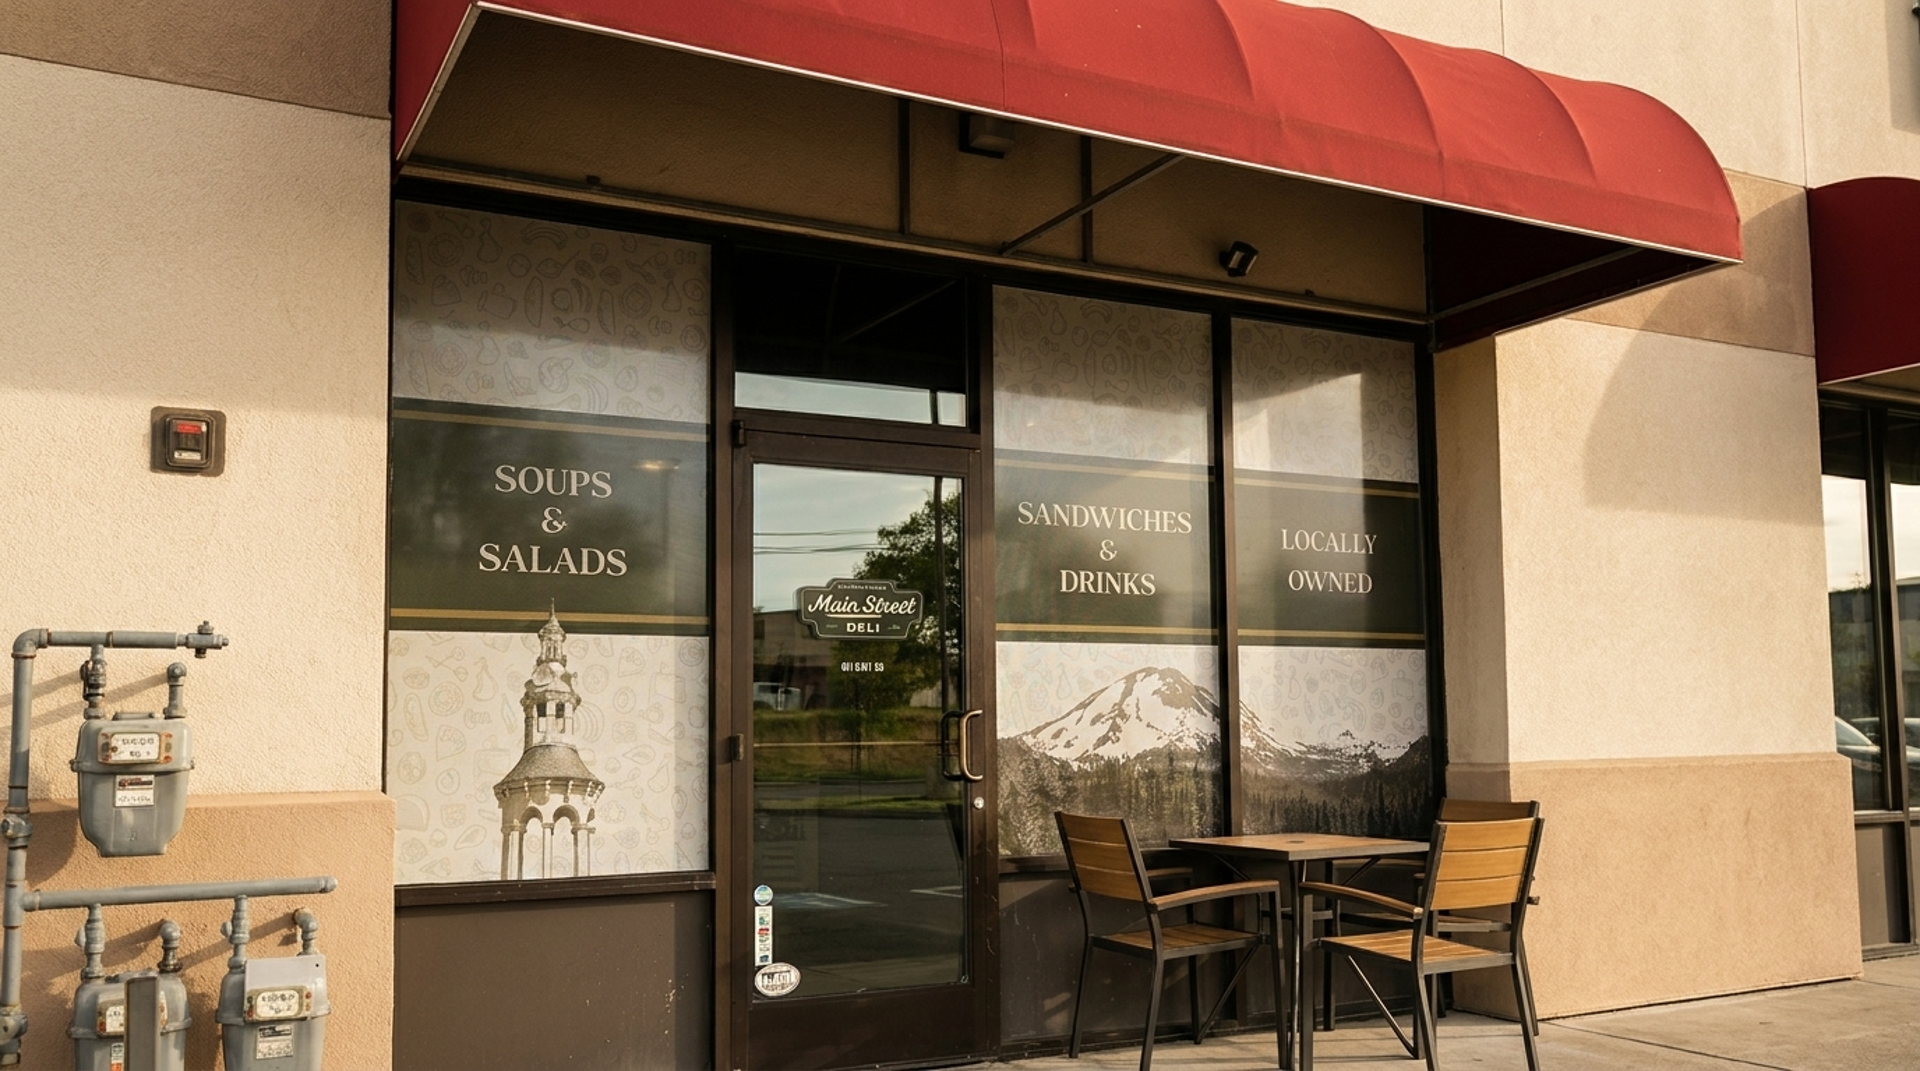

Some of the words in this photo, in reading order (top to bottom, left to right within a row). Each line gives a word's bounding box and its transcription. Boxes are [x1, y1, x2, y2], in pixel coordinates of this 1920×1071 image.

[494, 464, 613, 499] SOUPS
[540, 506, 568, 534] &
[1017, 501, 1193, 534] SANDWICHES
[1099, 539, 1118, 562] &
[1281, 528, 1377, 555] LOCALLY
[479, 543, 628, 577] SALADS
[1059, 569, 1157, 597] DRINKS
[1288, 569, 1373, 594] OWNED
[807, 593, 861, 613] Main
[861, 594, 917, 615] Street
[846, 622, 880, 633] DELI
